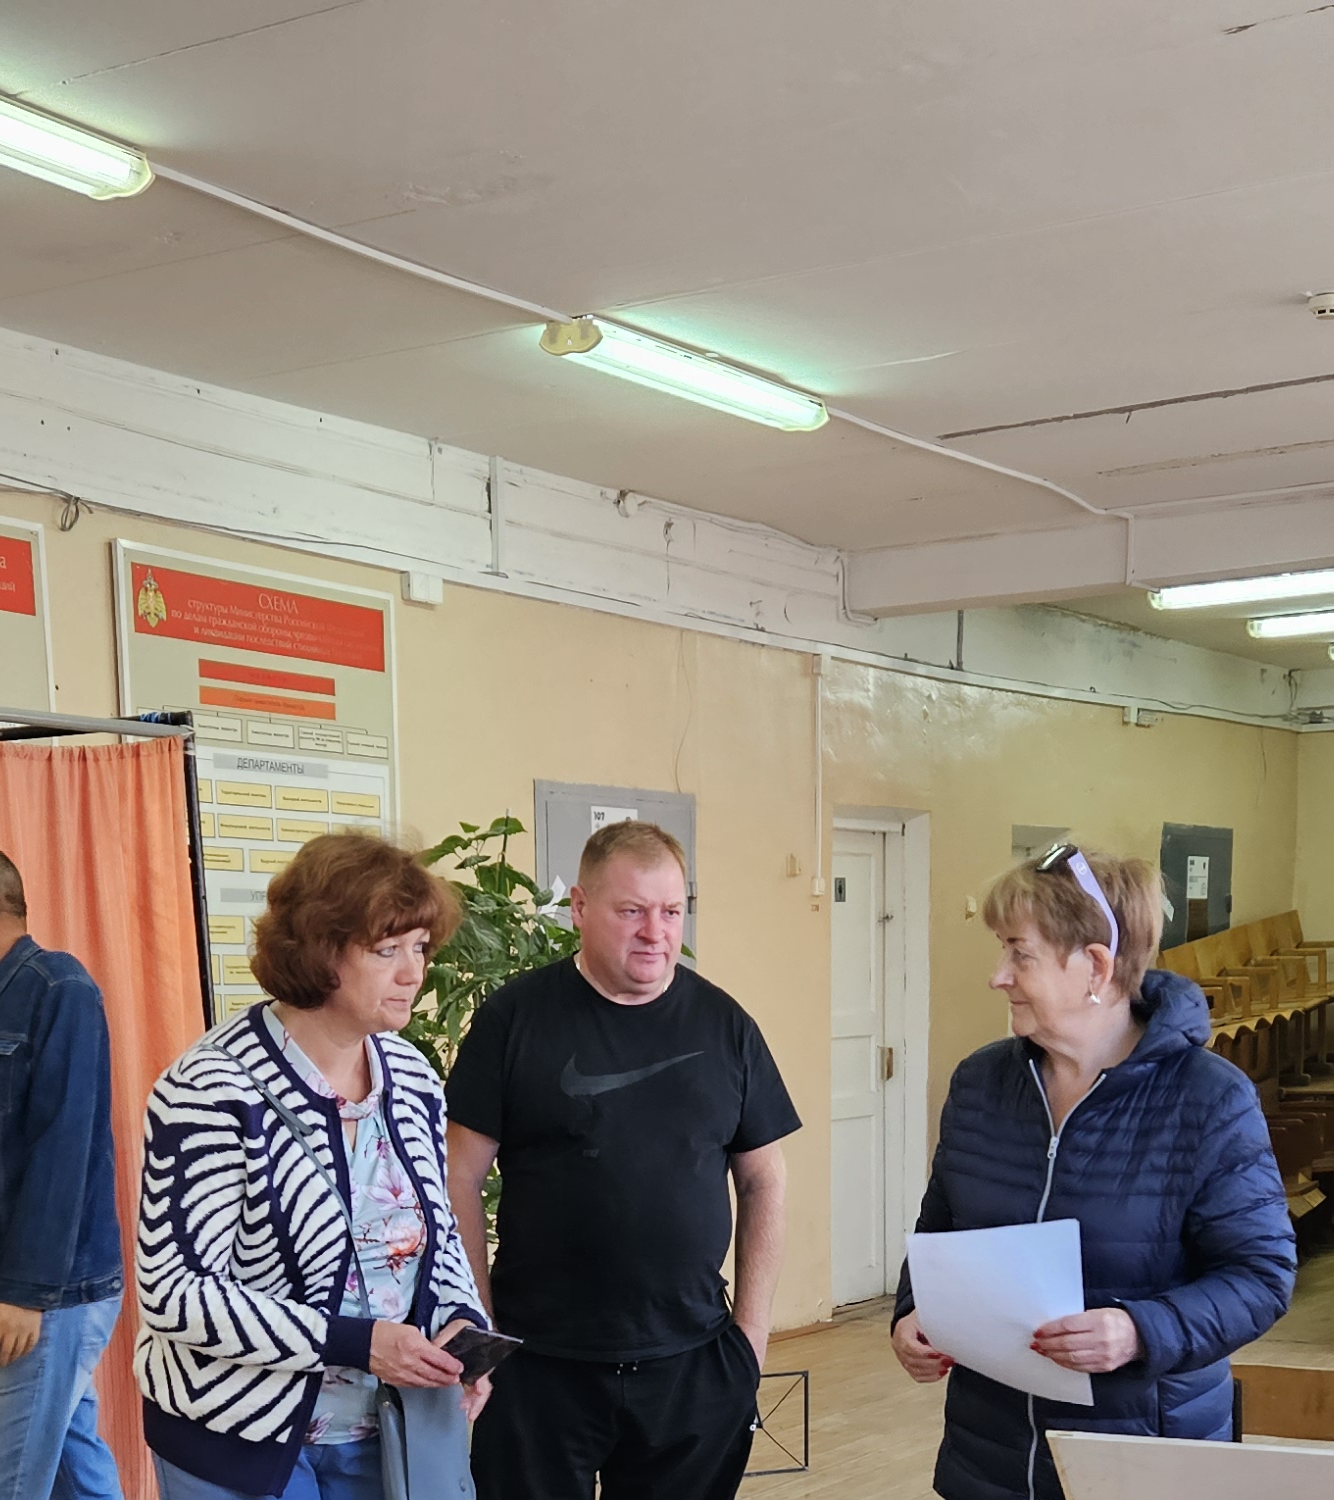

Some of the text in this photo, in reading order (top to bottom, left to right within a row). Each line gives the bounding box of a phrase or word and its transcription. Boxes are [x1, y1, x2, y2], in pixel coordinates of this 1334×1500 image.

[259, 593, 299, 614] СХЕМА
[171, 609, 182, 620] по
[237, 757, 305, 775] ДЕПАРТАМЕНТЫ
